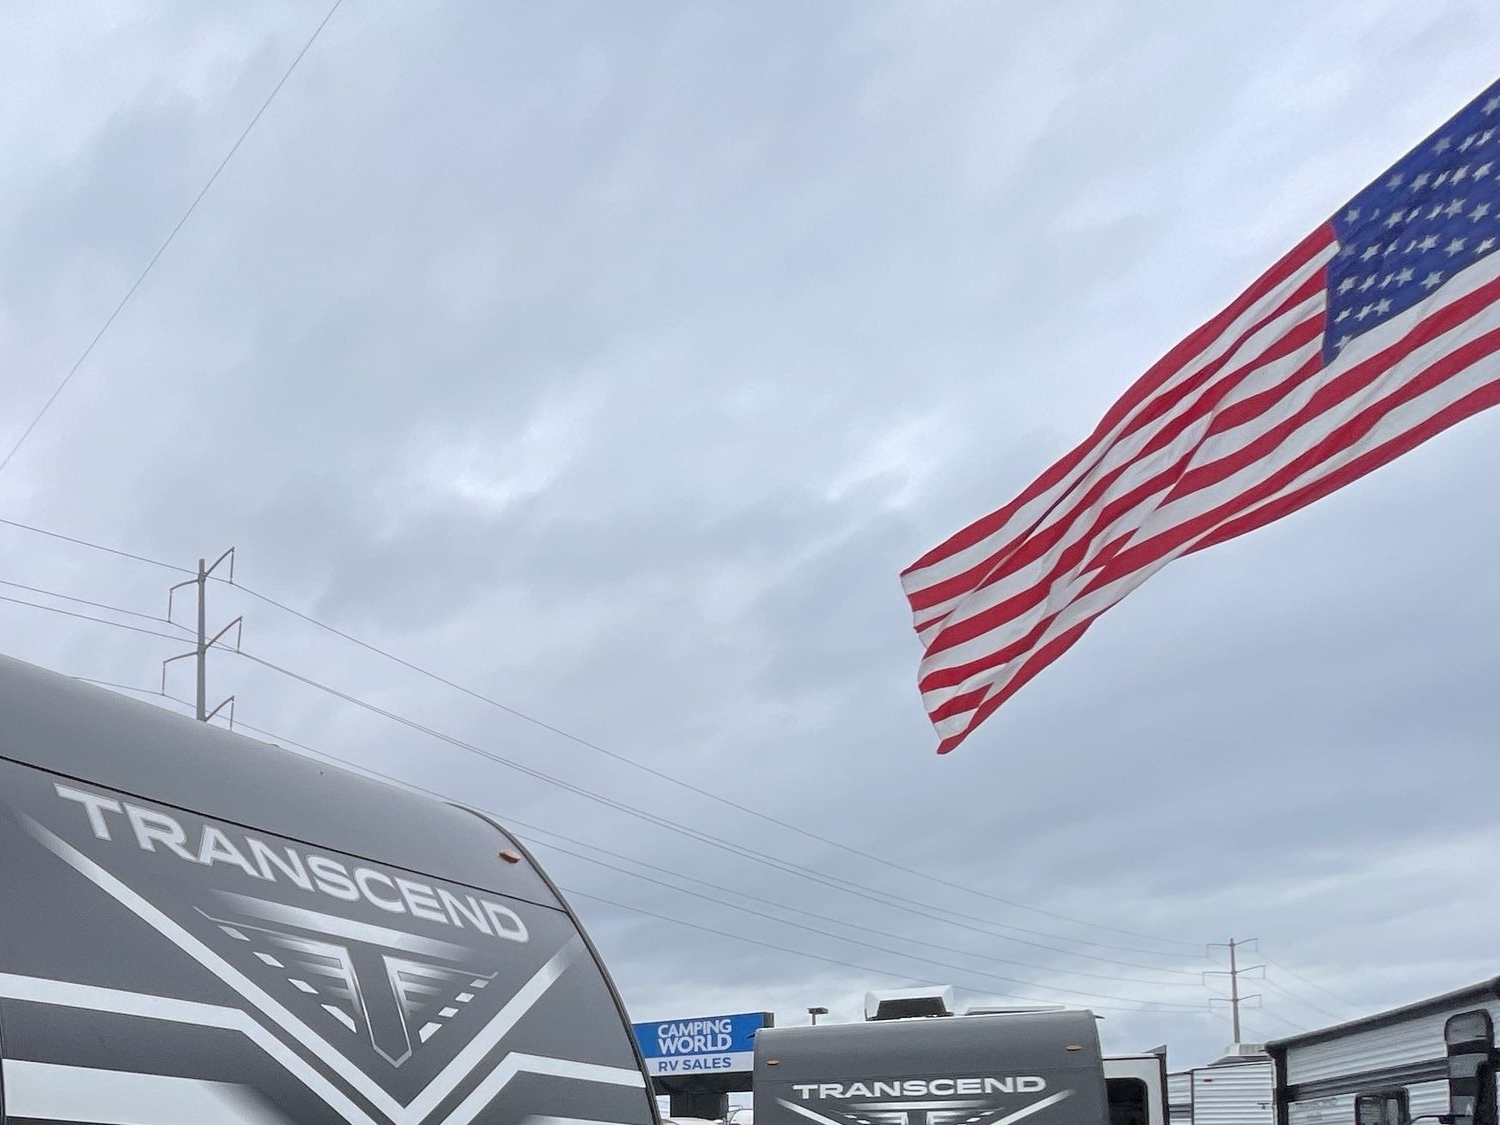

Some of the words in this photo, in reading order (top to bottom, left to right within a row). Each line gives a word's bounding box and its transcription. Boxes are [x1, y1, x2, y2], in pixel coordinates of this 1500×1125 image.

[54, 783, 529, 943] TRANSCEND
[658, 1019, 732, 1038] CAMPING
[658, 1034, 732, 1055] WORLD
[659, 1061, 679, 1072] RV
[683, 1057, 731, 1071] SALES
[792, 1076, 1046, 1099] TRANSCEND
